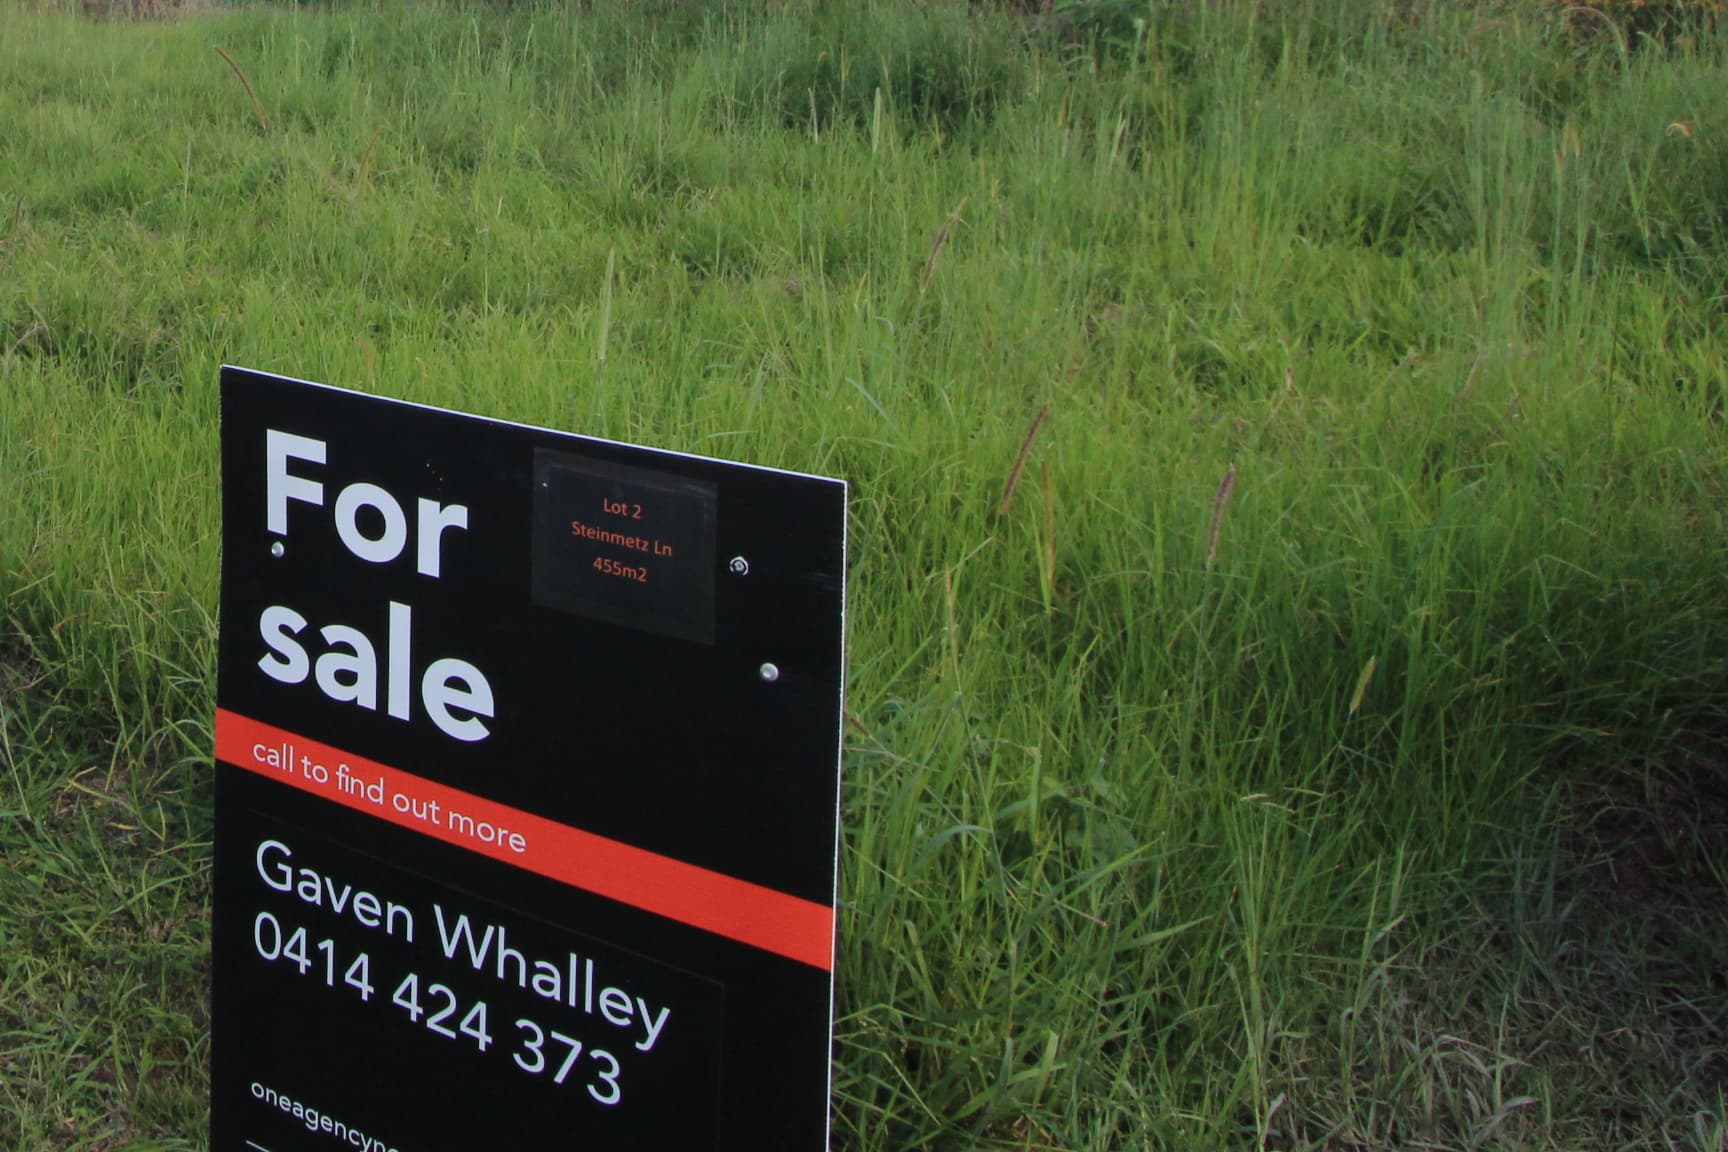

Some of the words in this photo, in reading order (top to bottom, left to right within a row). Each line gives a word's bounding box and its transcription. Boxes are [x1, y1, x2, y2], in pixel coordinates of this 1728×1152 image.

[266, 428, 468, 578] For
[571, 520, 649, 553] Steinmetz
[654, 540, 672, 557] Ln
[603, 497, 629, 517] Lot
[632, 504, 642, 520] 2
[592, 556, 647, 583] 455m2
[257, 600, 495, 742] sale
[252, 742, 294, 773] call
[300, 754, 329, 785] to
[335, 762, 384, 806] find
[392, 792, 441, 825] out
[448, 810, 527, 854] more
[254, 911, 374, 1002] 0414
[392, 973, 493, 1052] 424
[513, 1019, 622, 1105] 373
[256, 839, 413, 943] Gaven
[433, 903, 671, 1051] Whalley
